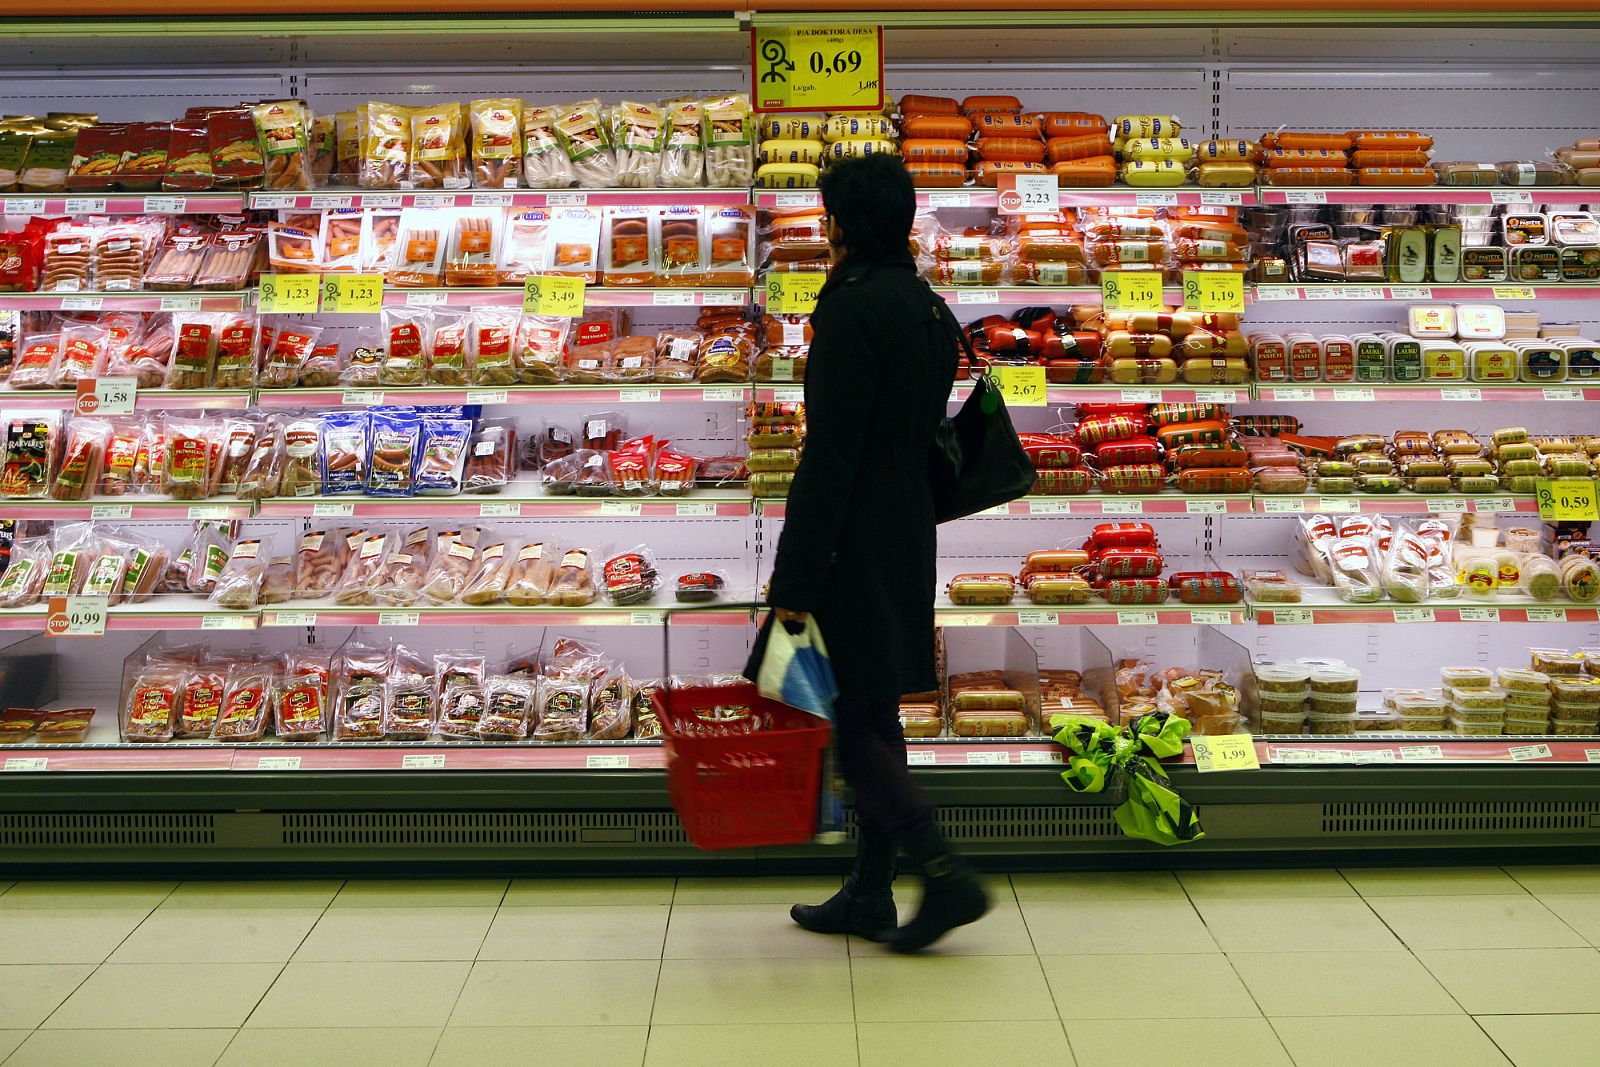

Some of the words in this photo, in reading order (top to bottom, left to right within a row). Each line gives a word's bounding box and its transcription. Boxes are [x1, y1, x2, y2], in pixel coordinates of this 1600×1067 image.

[809, 50, 862, 78] 0,69
[1002, 197, 1021, 205] STOP
[1025, 193, 1050, 204] 2,23
[286, 288, 309, 299] 1,23
[350, 289, 373, 299] 1,23
[550, 291, 575, 302] 3,49
[794, 291, 818, 303] 1,29
[1129, 291, 1153, 302] 1,19
[1210, 291, 1234, 302] 1,19
[1013, 384, 1037, 396] 2,67
[104, 392, 128, 403] 1,58
[80, 400, 99, 408] STOP
[8, 440, 45, 449] RAKVERES
[1560, 495, 1590, 510] 0,59
[51, 620, 70, 628] STOP
[71, 612, 100, 626] 0,99
[1222, 749, 1246, 760] 1,99
